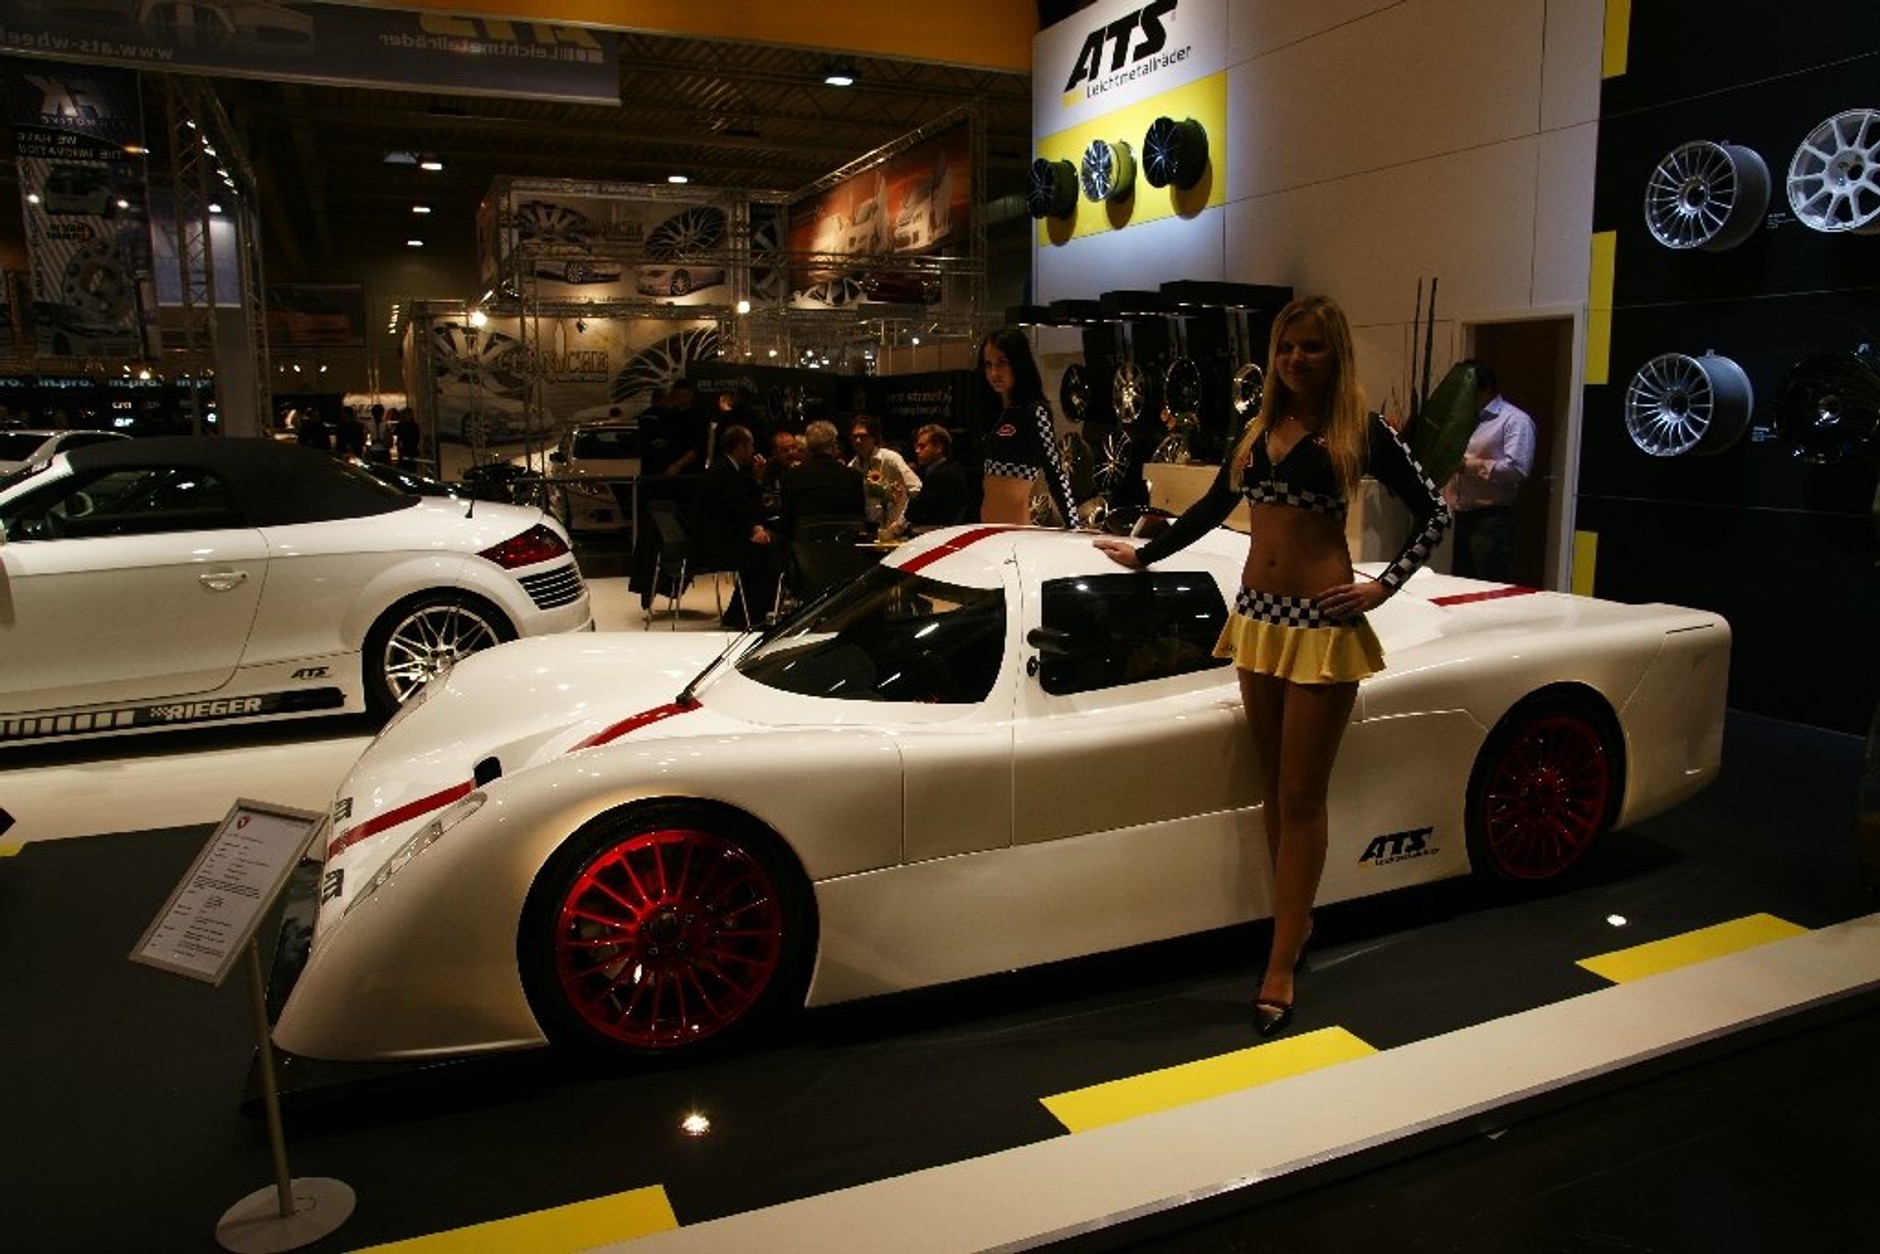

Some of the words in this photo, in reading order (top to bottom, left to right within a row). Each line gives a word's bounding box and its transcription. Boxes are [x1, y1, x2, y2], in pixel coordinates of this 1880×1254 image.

[1064, 0, 1178, 92] ATS
[1087, 46, 1192, 98] Leichtmetallräder
[291, 666, 329, 679] ATS
[164, 697, 262, 721] RIEGER
[1359, 826, 1433, 862] ATS
